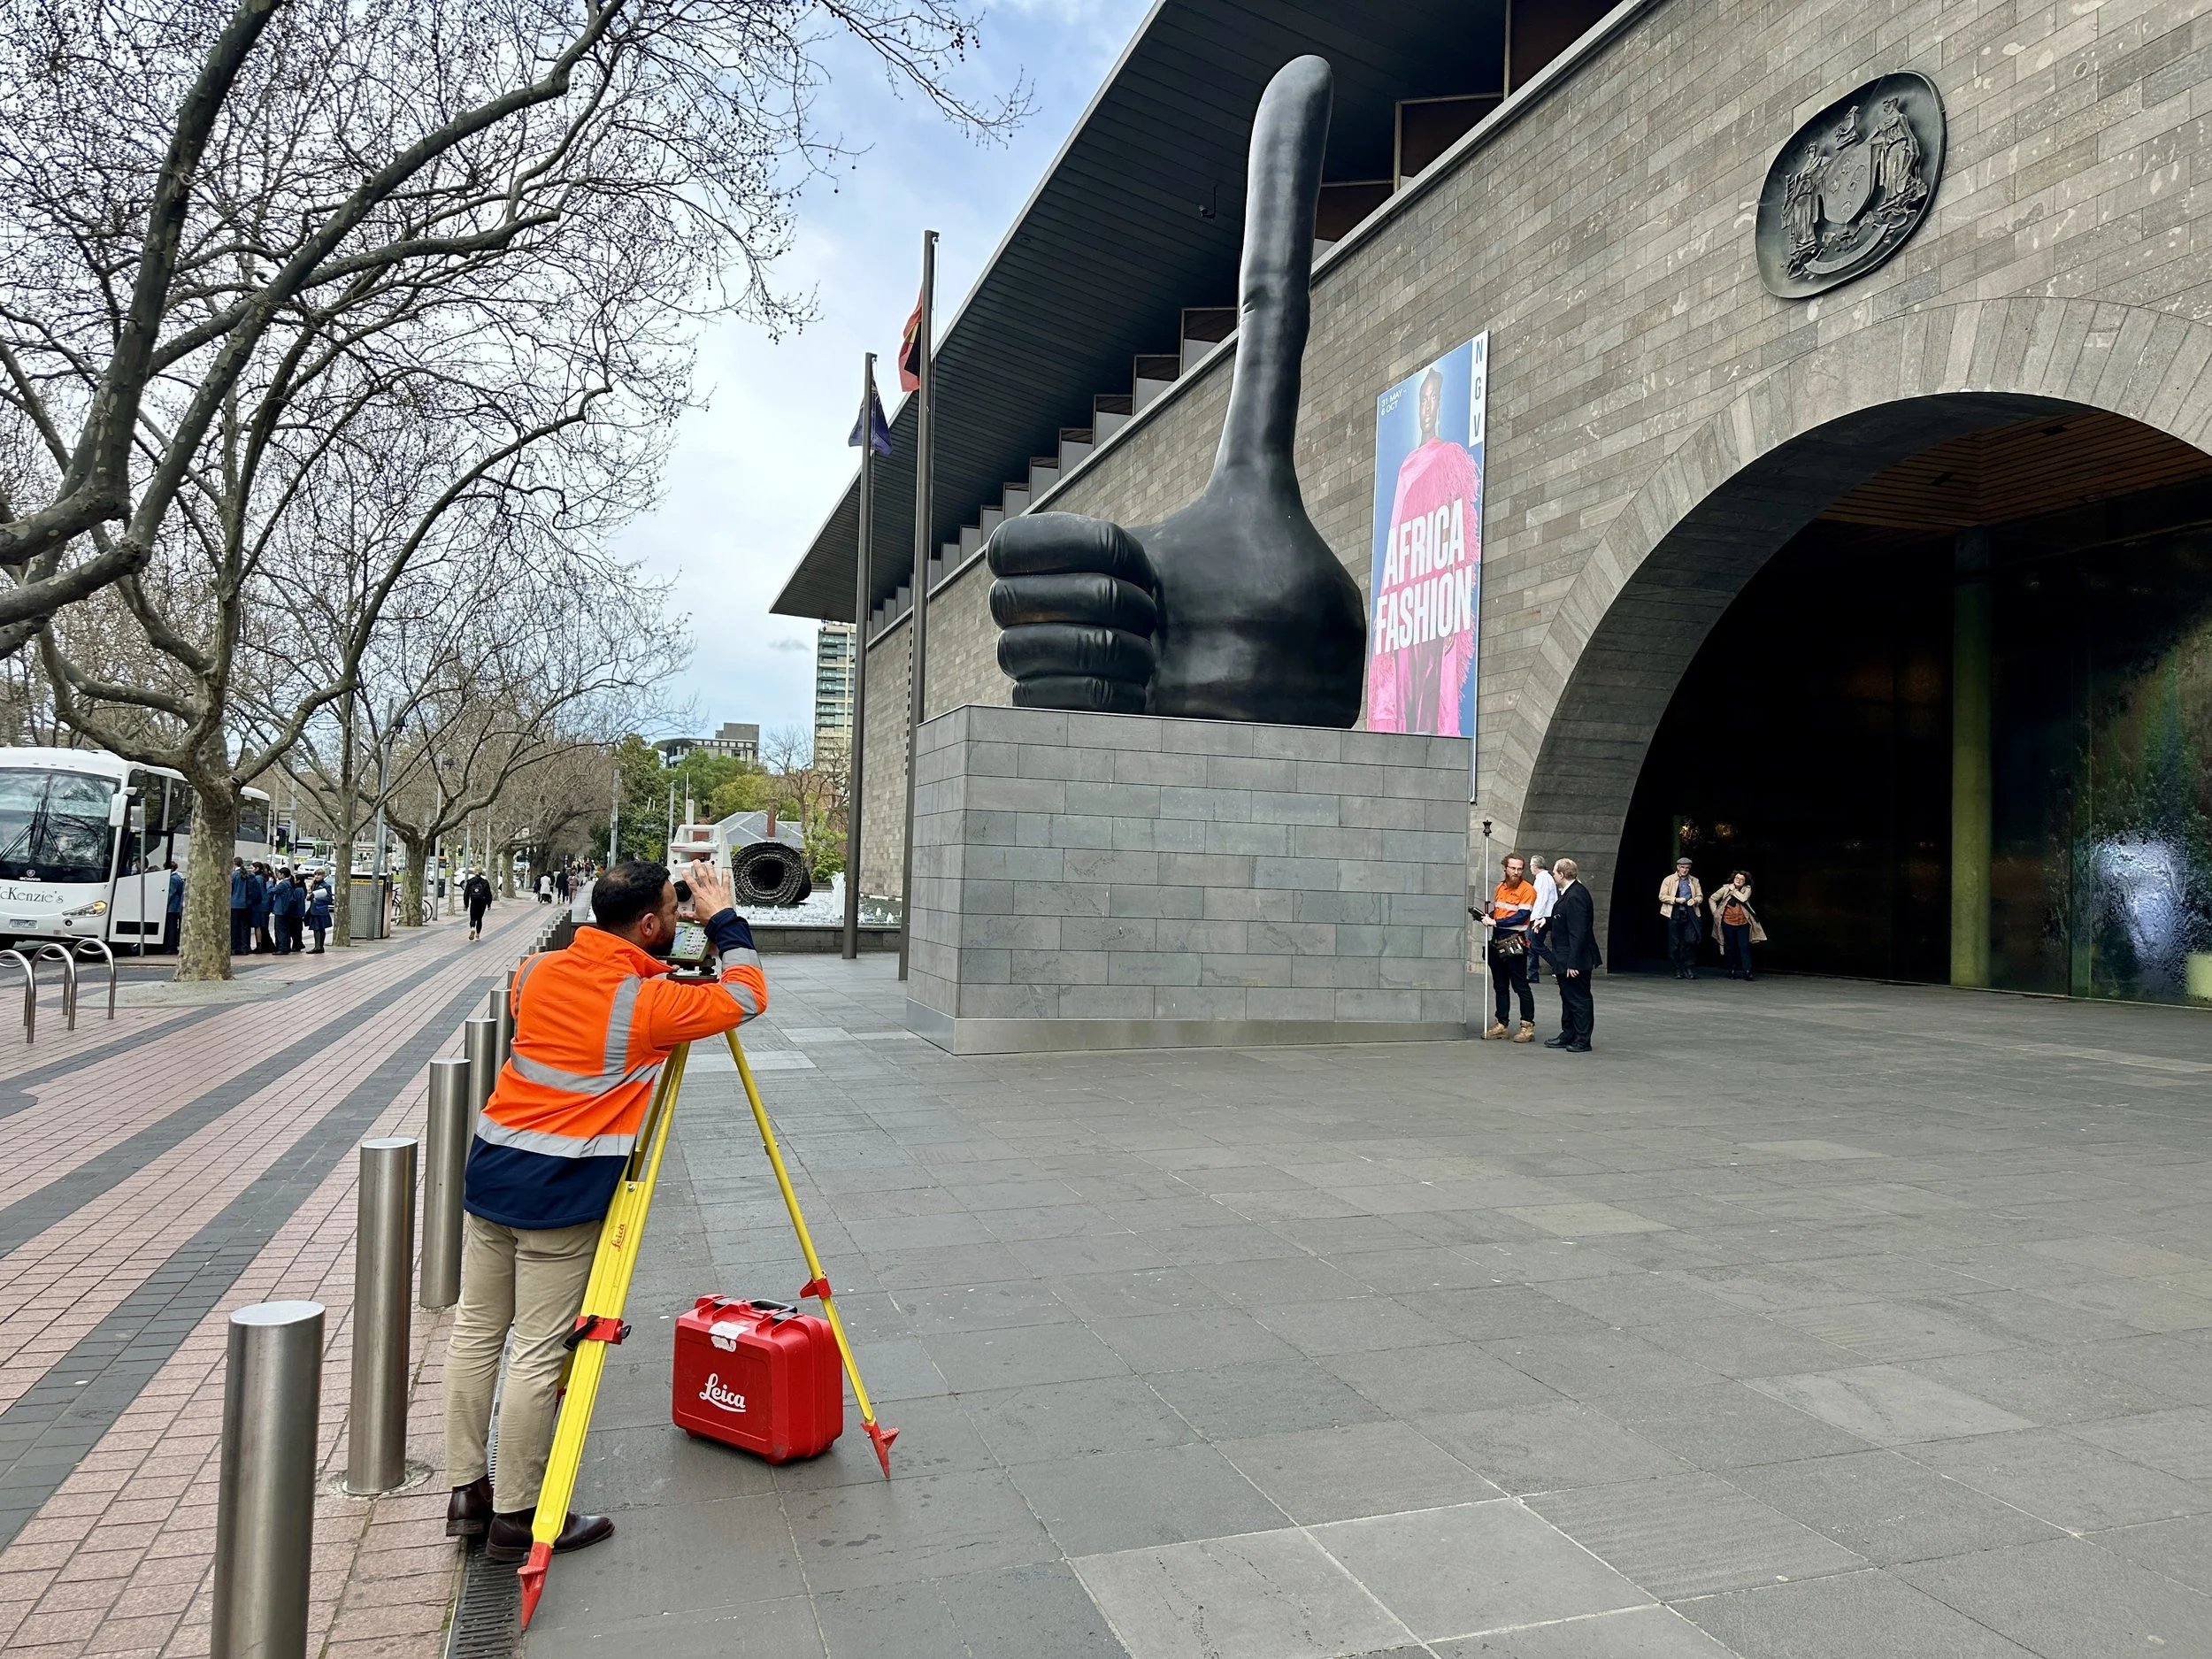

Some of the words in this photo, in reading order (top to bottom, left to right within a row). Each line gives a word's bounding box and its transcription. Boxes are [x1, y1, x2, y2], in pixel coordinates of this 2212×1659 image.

[1381, 397, 1388, 407] 31
[1389, 389, 1402, 403] MAY
[1386, 400, 1398, 412] OCT
[1384, 498, 1465, 589] AFRICA
[1376, 565, 1472, 656] FASHION
[0, 886, 64, 903] cKenzie's
[611, 1224, 626, 1252] Leica
[699, 1373, 746, 1412] Leica
